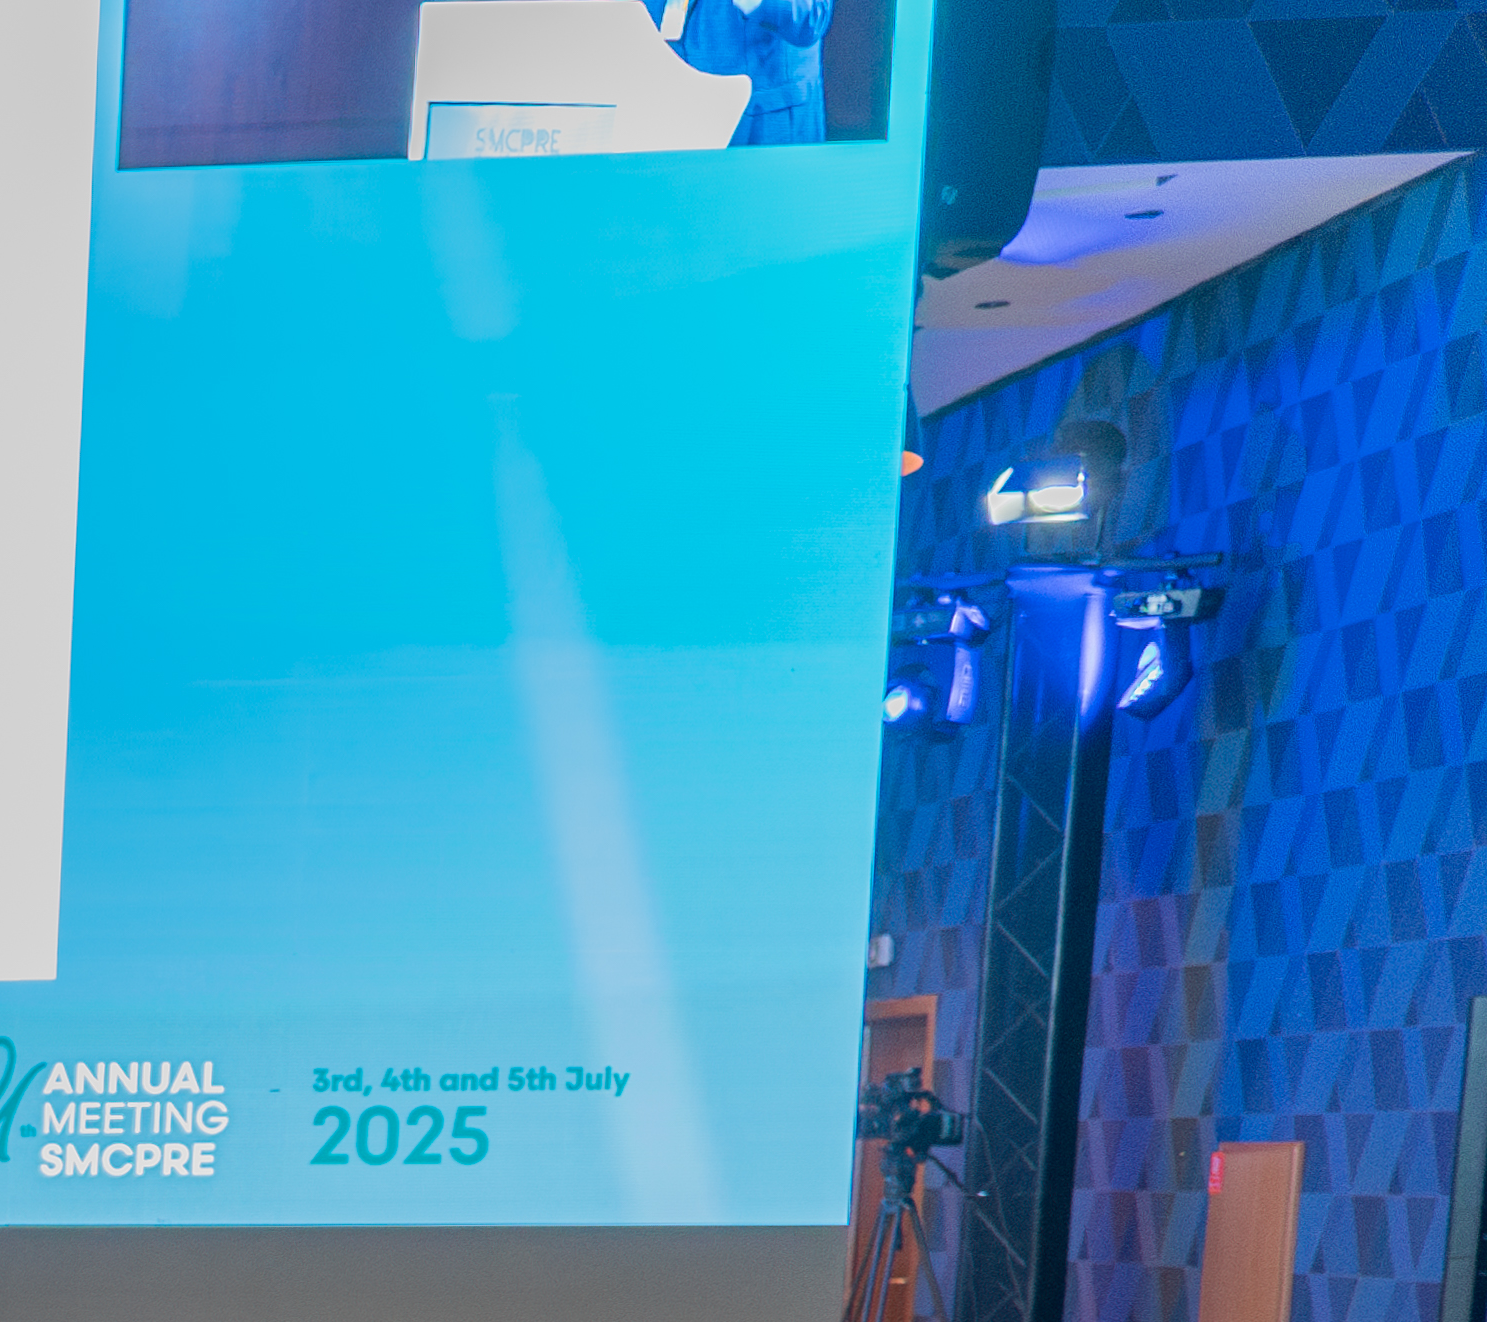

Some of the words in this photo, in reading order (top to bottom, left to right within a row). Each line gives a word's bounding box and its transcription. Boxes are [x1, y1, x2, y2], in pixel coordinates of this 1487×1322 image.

[475, 128, 562, 153] SMCPRE
[42, 1061, 225, 1095] ANNUAL
[313, 1067, 372, 1097] 3rd,
[380, 1067, 431, 1092] 4th
[439, 1066, 499, 1091] and
[508, 1066, 557, 1091] 5th
[565, 1066, 630, 1097] July
[42, 1100, 229, 1135] MEETING
[309, 1105, 489, 1166] 2025
[40, 1141, 216, 1177] SMCPRE
